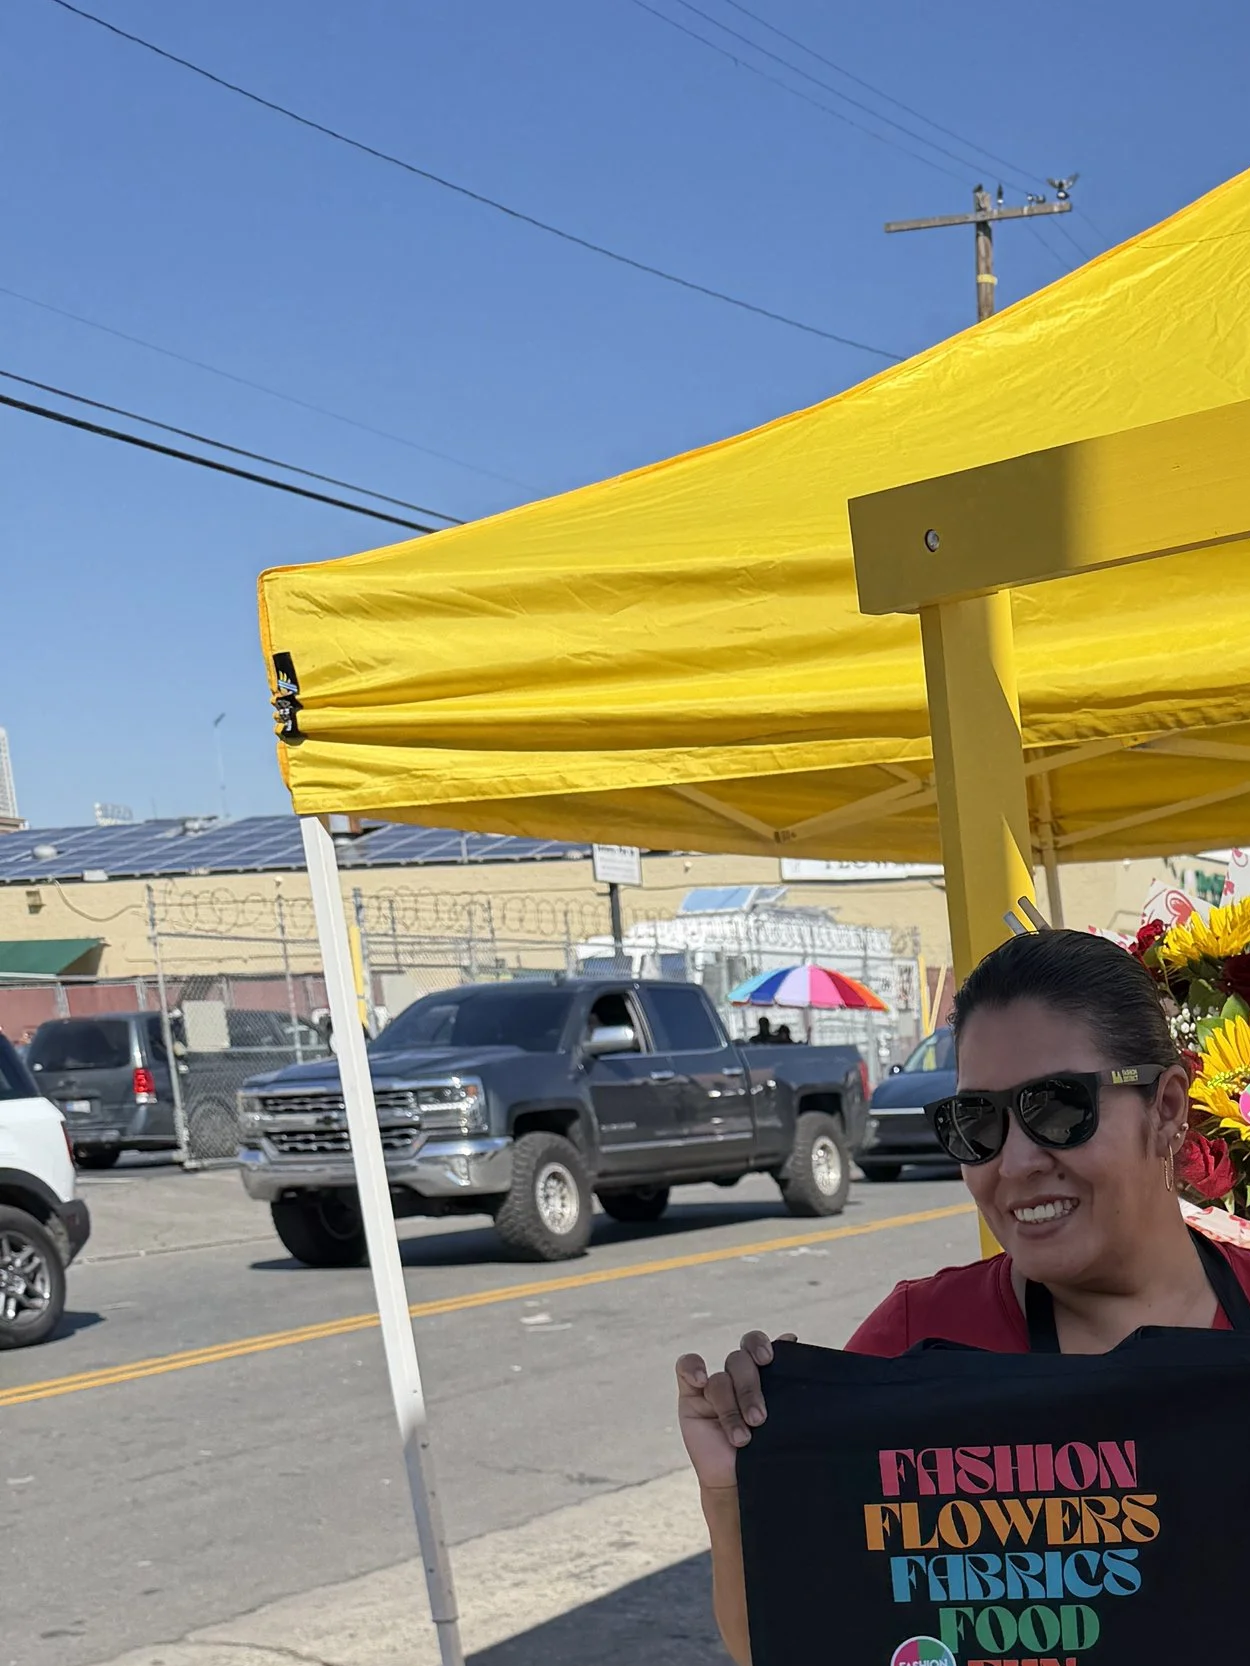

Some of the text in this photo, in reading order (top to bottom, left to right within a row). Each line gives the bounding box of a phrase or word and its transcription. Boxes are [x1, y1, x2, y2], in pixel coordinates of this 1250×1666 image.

[879, 1440, 1138, 1496] FASHION
[863, 1494, 1161, 1551] FLOWERS
[889, 1548, 1142, 1603] FABRICS
[939, 1604, 1100, 1654] FOOD
